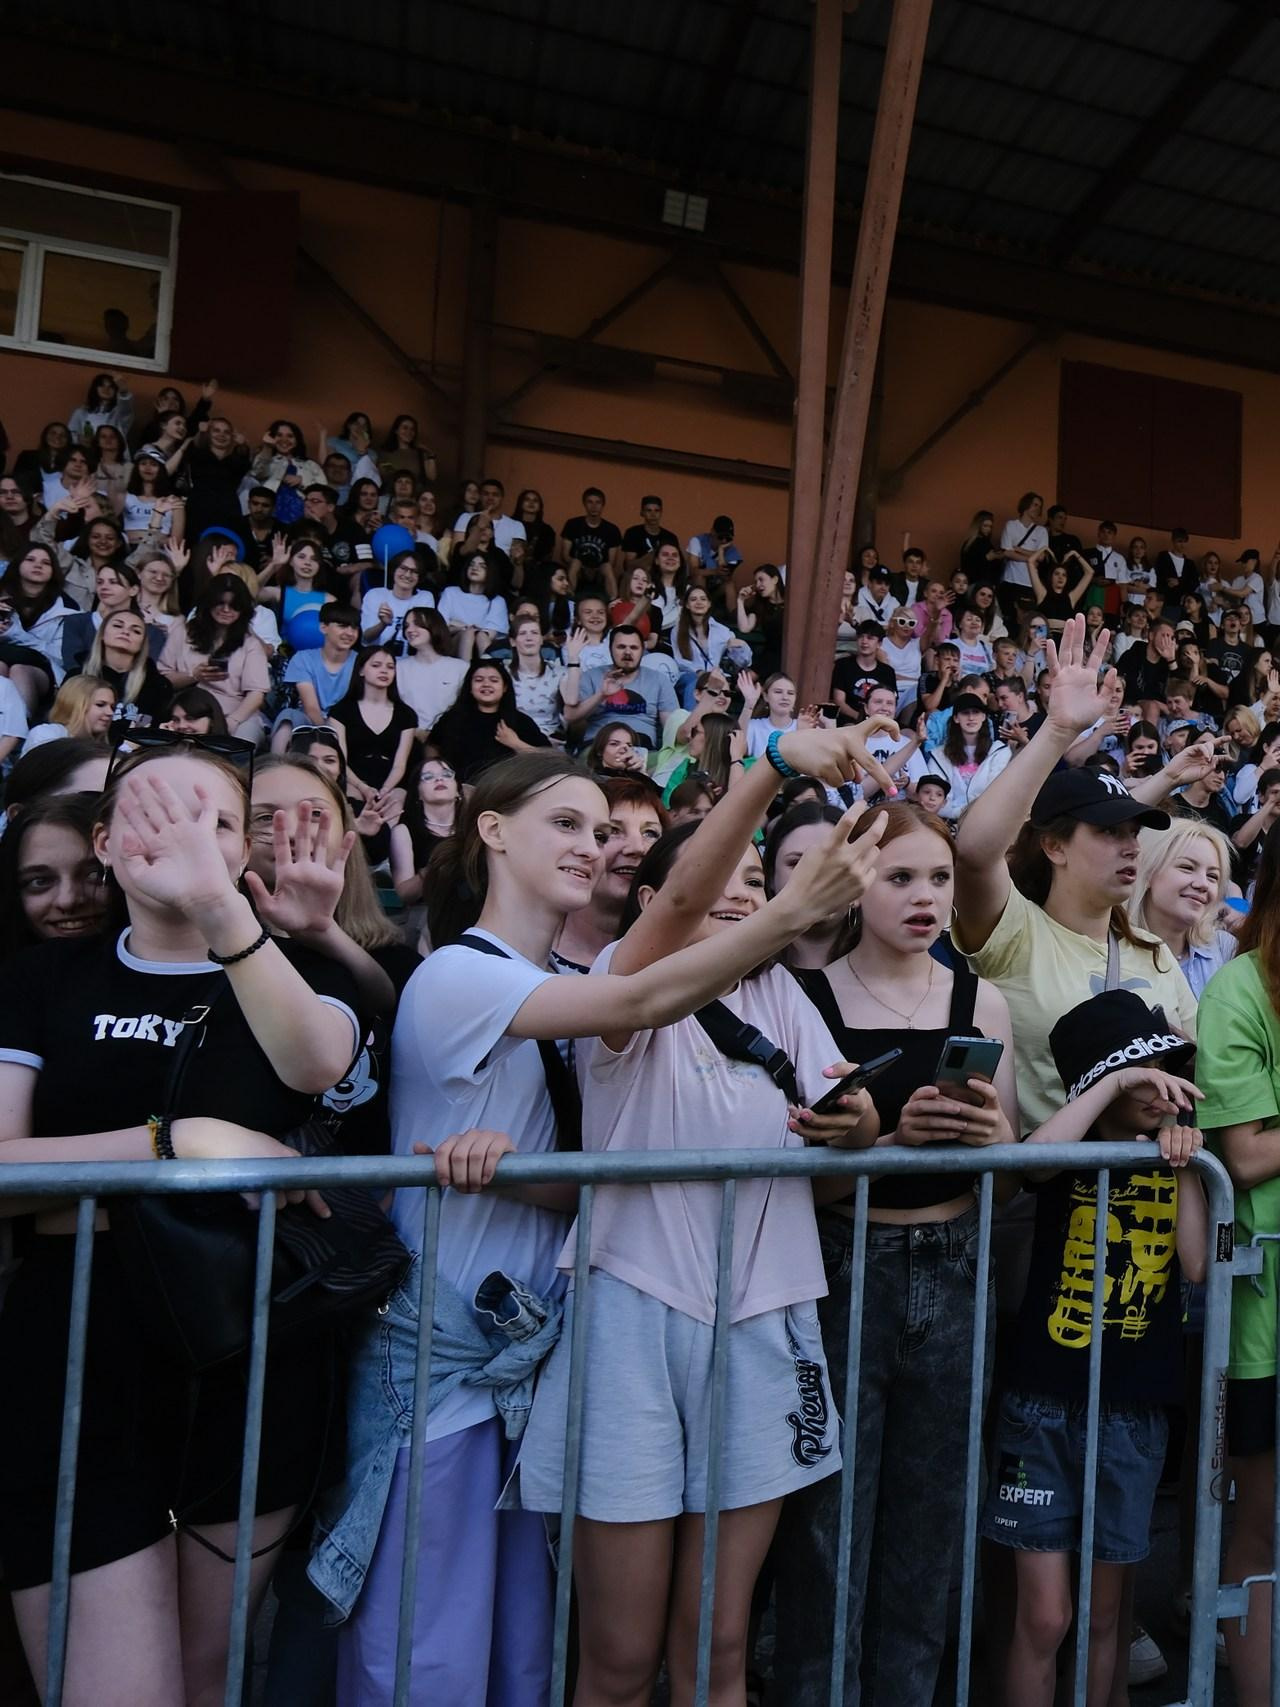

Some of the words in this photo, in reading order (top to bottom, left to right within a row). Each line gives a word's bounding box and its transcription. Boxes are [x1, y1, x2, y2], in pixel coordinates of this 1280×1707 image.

[93, 1013, 207, 1048] TOKY
[1105, 1033, 1185, 1068] adida
[999, 1484, 1055, 1507] EXPERT
[994, 1515, 1019, 1529] EXPERT
